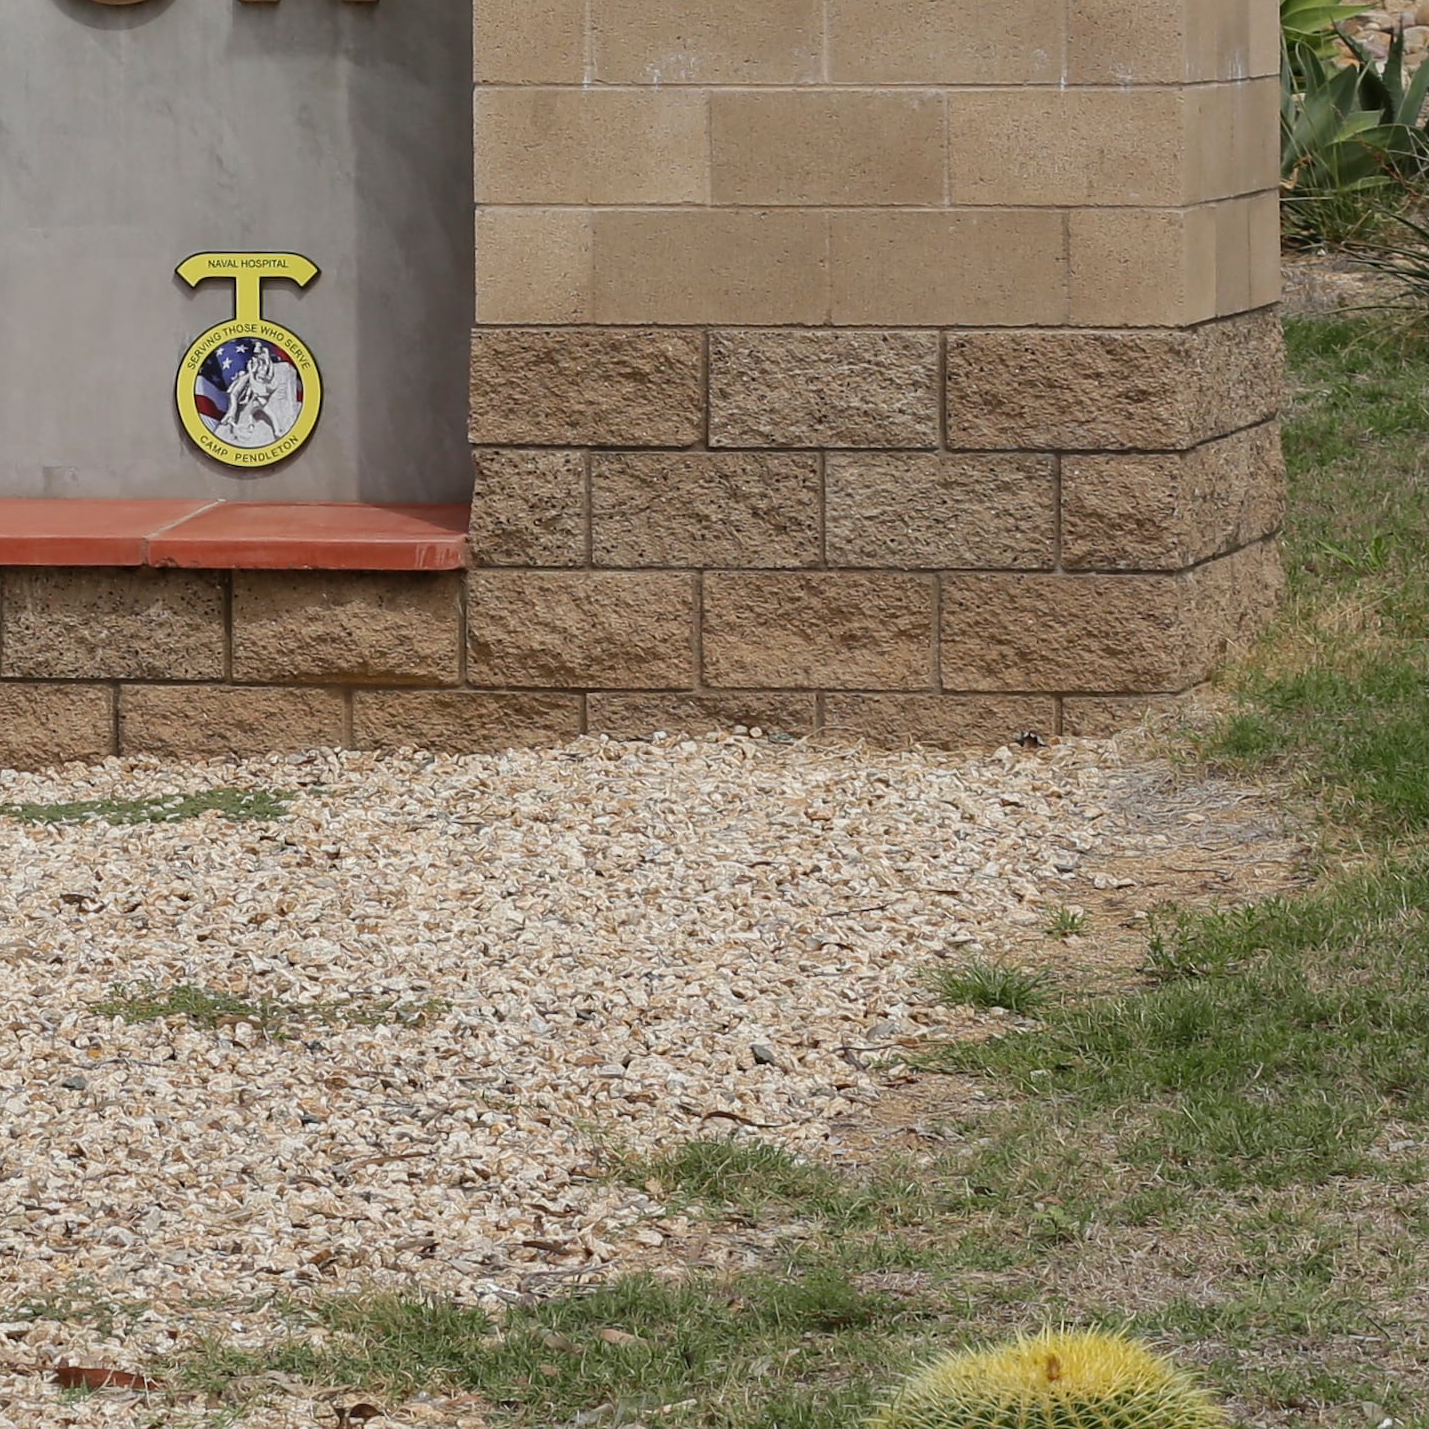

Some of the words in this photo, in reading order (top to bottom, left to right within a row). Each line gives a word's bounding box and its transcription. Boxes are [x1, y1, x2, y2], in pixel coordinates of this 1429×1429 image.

[208, 260, 238, 268] NAVAL
[241, 260, 288, 268] HOSPITAL
[188, 333, 221, 370] SERVING
[223, 324, 257, 336] THOSE
[261, 326, 283, 341] WHO
[284, 340, 311, 369] SERVE
[200, 435, 228, 457] CAMP
[235, 435, 298, 462] PENDLETON
